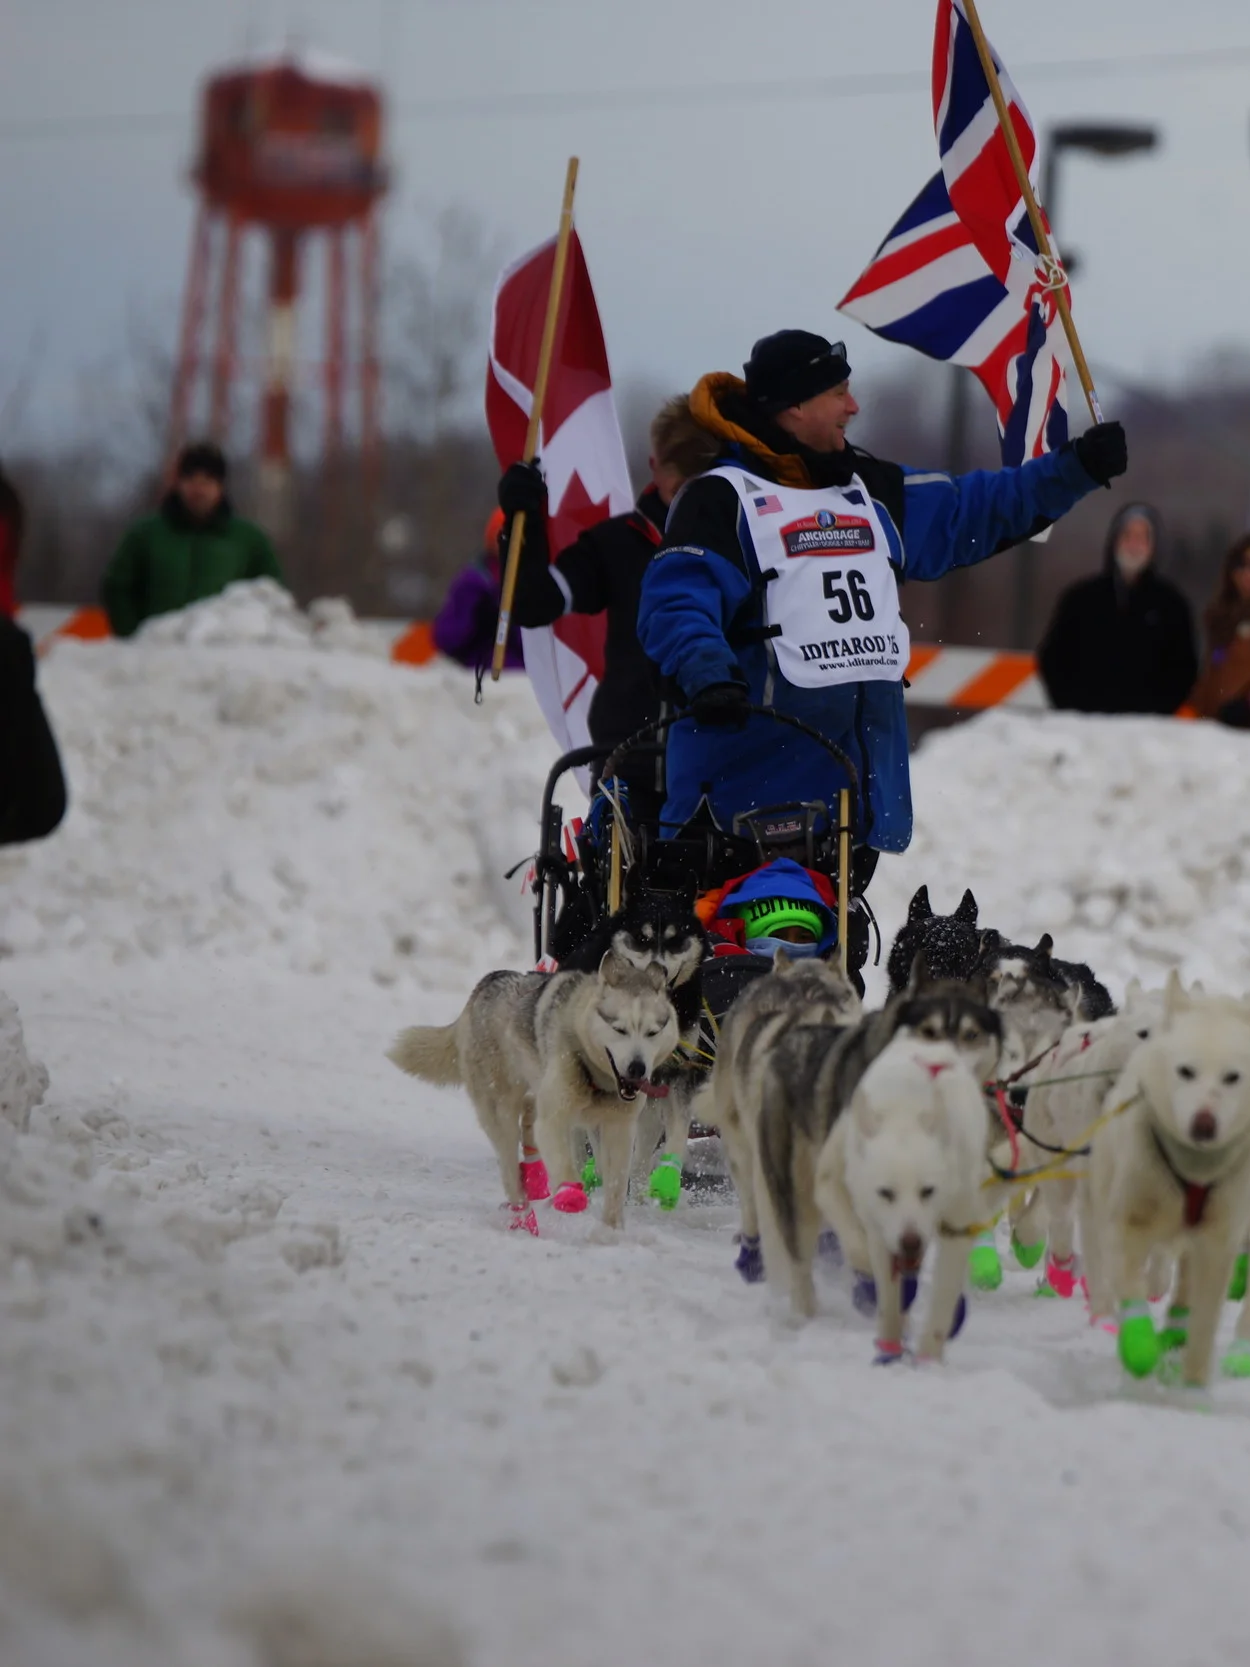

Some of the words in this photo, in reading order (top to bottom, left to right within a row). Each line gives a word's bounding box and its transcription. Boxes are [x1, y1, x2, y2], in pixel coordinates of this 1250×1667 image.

[798, 529, 861, 543] ANCHORAGE
[822, 569, 875, 624] 56
[799, 635, 887, 661] IDITAROD
